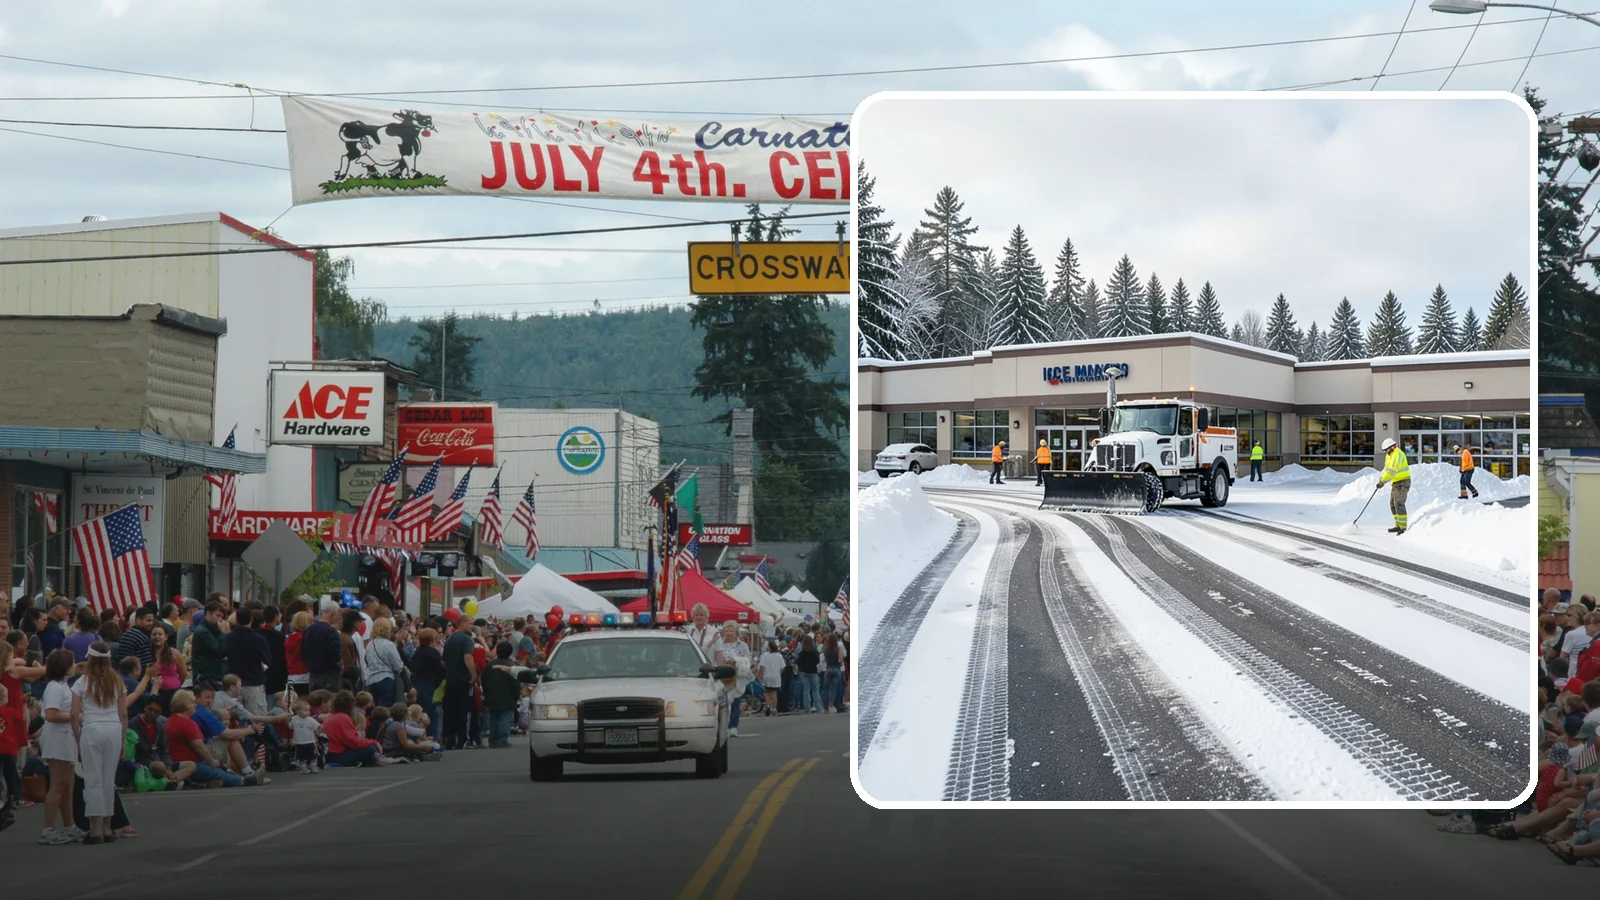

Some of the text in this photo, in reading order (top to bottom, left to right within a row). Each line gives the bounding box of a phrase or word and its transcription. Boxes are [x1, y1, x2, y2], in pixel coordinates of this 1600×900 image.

[694, 121, 850, 150] Carnat
[481, 141, 605, 192] JULY
[632, 149, 746, 198] 4th.
[697, 254, 850, 280] CROSSWA
[283, 380, 373, 420] ACE
[405, 409, 485, 422] CEDAR LOG
[283, 421, 371, 437] Hardware
[416, 428, 477, 447] Coca-Cola
[83, 484, 155, 495] St. Vincent de Paul
[688, 526, 742, 535] CRNATION
[699, 535, 730, 543] GLASS
